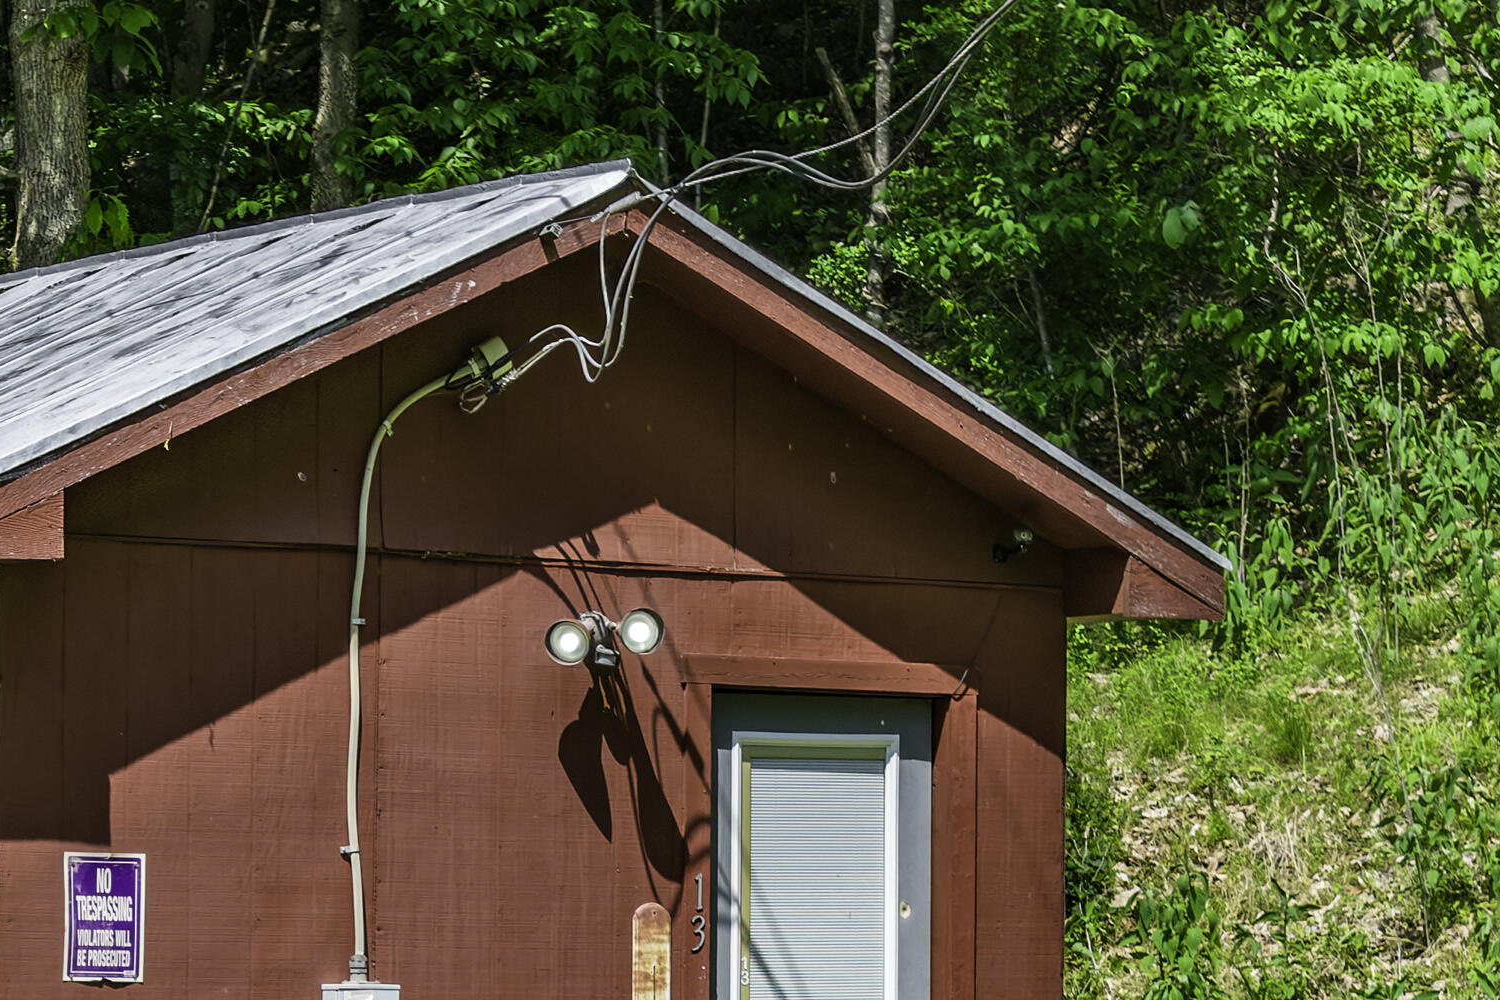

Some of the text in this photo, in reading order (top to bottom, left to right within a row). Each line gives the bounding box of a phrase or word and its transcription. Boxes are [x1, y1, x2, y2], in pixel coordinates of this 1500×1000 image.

[96, 867, 112, 894] NO
[76, 895, 132, 922] TRESPASSING
[77, 929, 132, 947] VIOLATORS WILL
[76, 950, 131, 968] BE PROSECUTED
